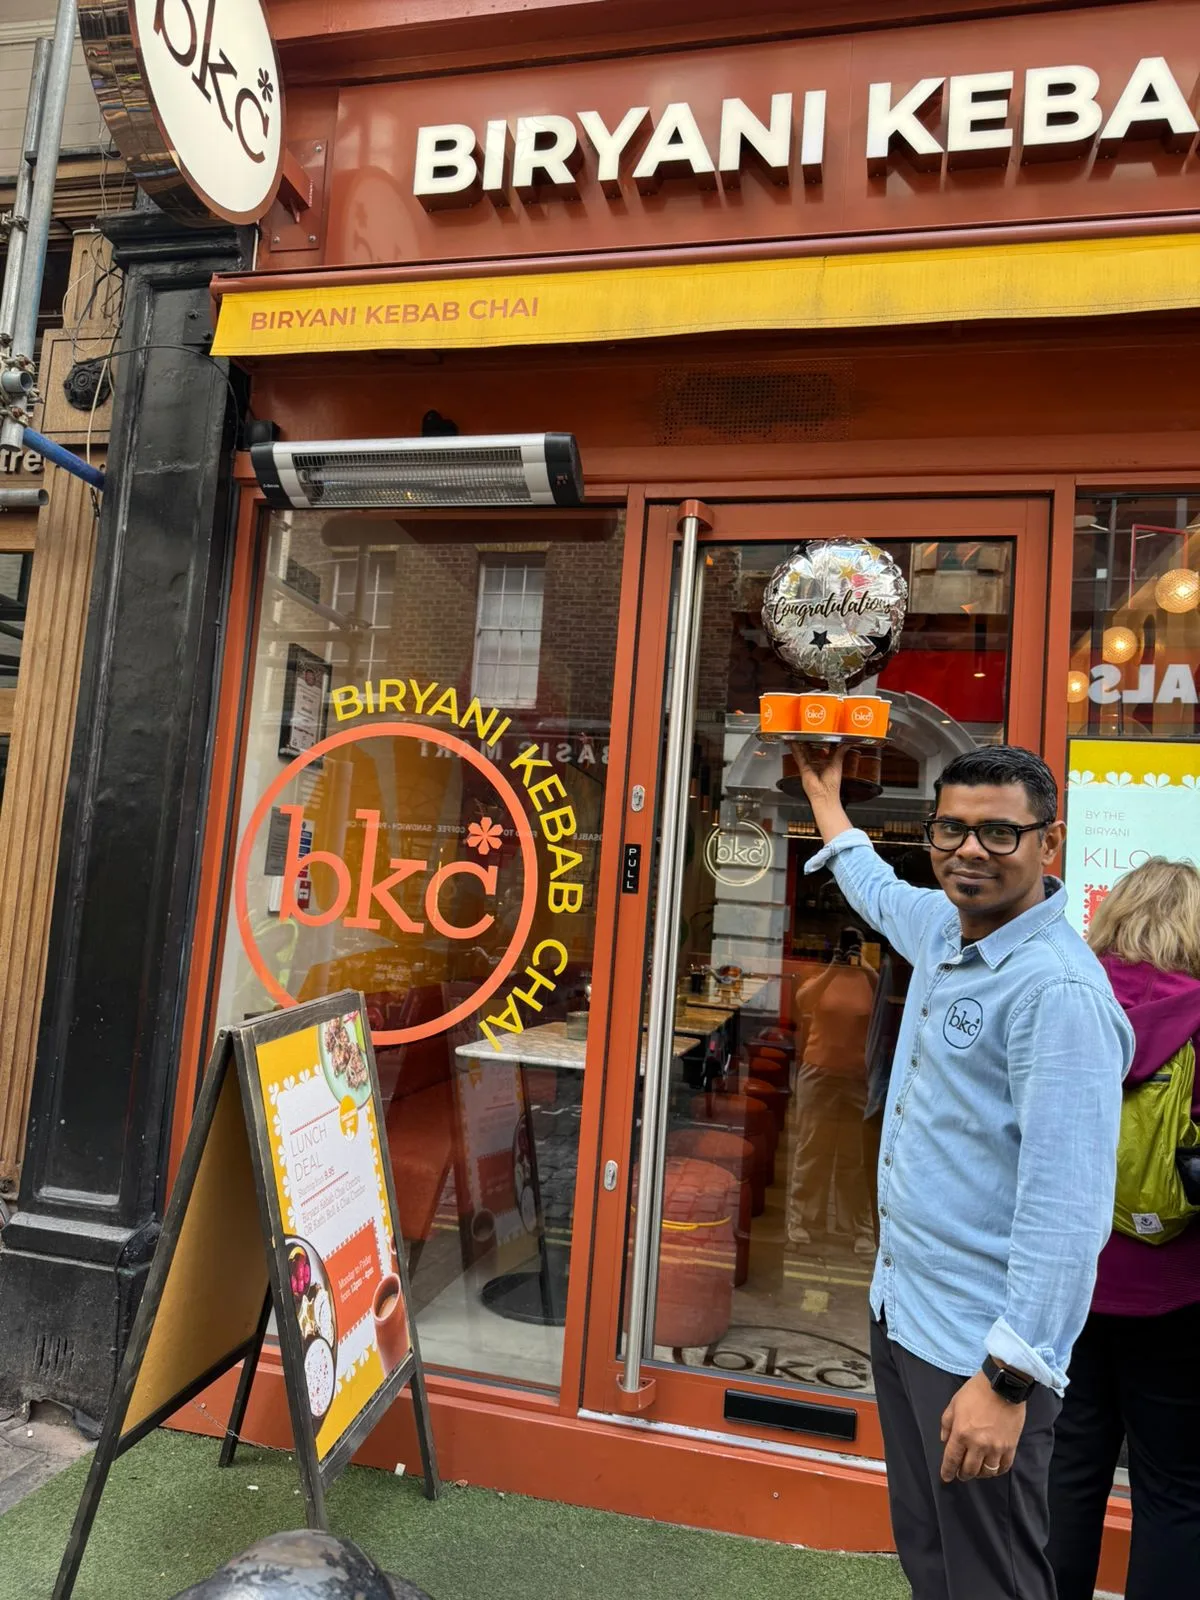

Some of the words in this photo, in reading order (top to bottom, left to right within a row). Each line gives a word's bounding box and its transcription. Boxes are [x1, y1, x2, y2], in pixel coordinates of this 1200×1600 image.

[413, 90, 826, 196] BIRYANI
[866, 57, 1199, 159] KEBA
[250, 306, 357, 331] BIRYANI
[365, 301, 459, 325] KEBAB
[469, 297, 539, 321] CHAI
[331, 679, 511, 746] BIRYANI
[510, 744, 583, 914] KEBAB
[1084, 826, 1130, 837] BIRYANI
[1085, 810, 1101, 820] BY
[1104, 811, 1126, 821] THE
[278, 805, 498, 939] bkc
[627, 848, 637, 889] PULL
[479, 939, 568, 1051] CHAI
[948, 1005, 979, 1036] bkc
[290, 1121, 328, 1157] LUNCH
[294, 1152, 324, 1182] DEAL
